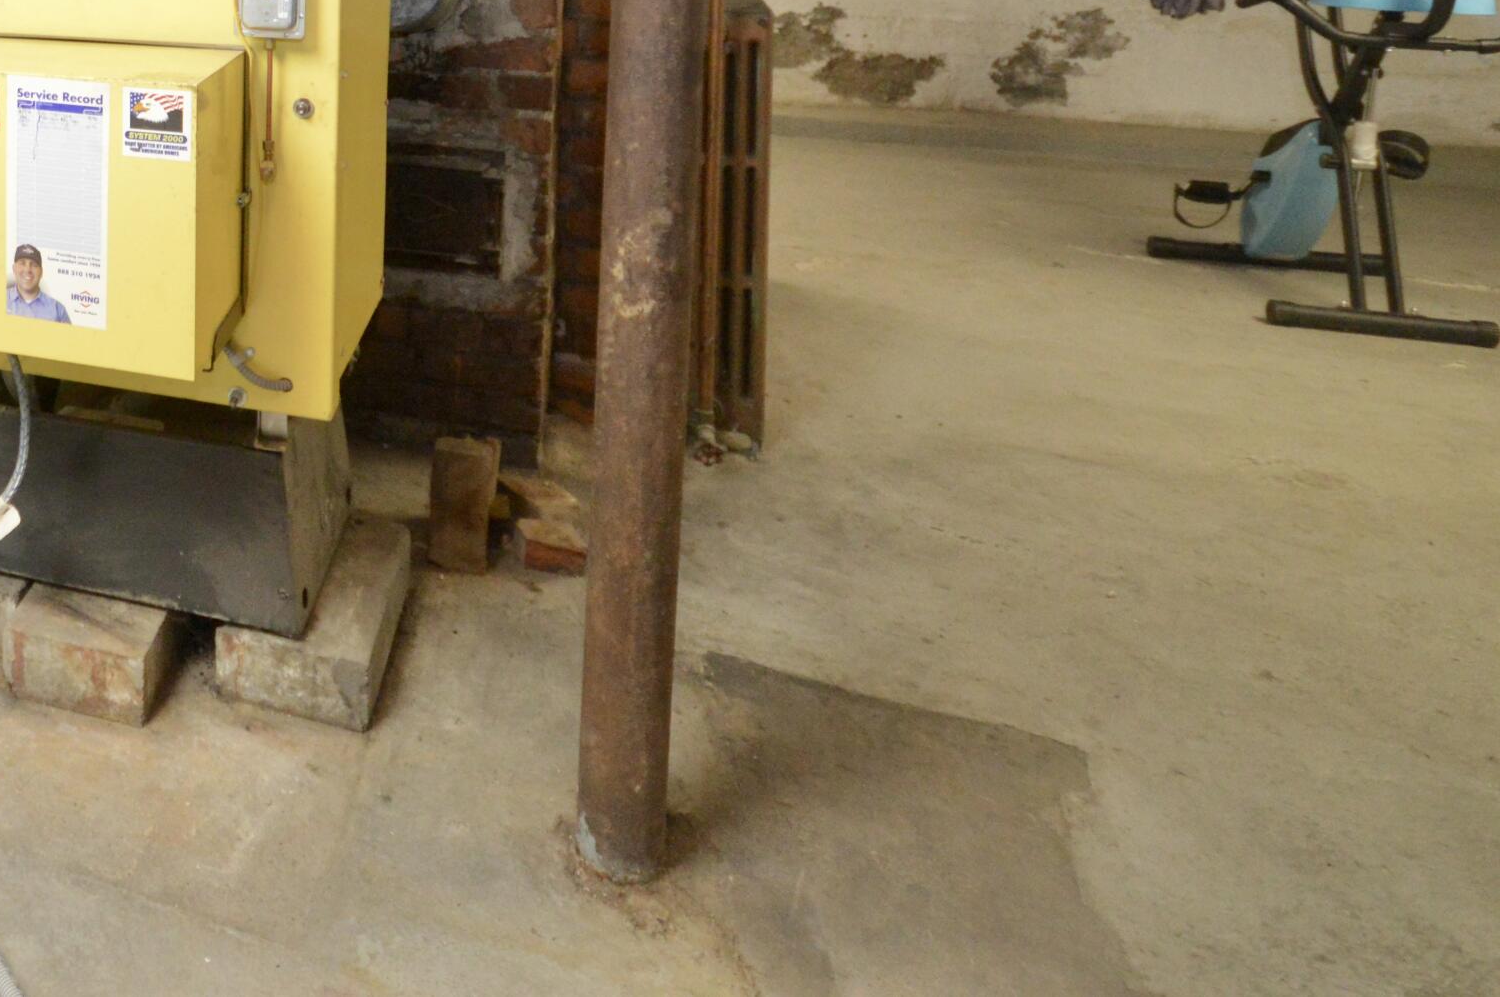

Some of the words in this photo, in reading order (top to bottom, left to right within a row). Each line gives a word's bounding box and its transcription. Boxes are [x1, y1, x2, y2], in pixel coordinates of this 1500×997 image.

[17, 88, 58, 101] Service
[63, 92, 103, 105] Record
[129, 132, 161, 141] SYSTEM
[163, 135, 184, 143] 2000
[71, 293, 100, 304] IRVING
